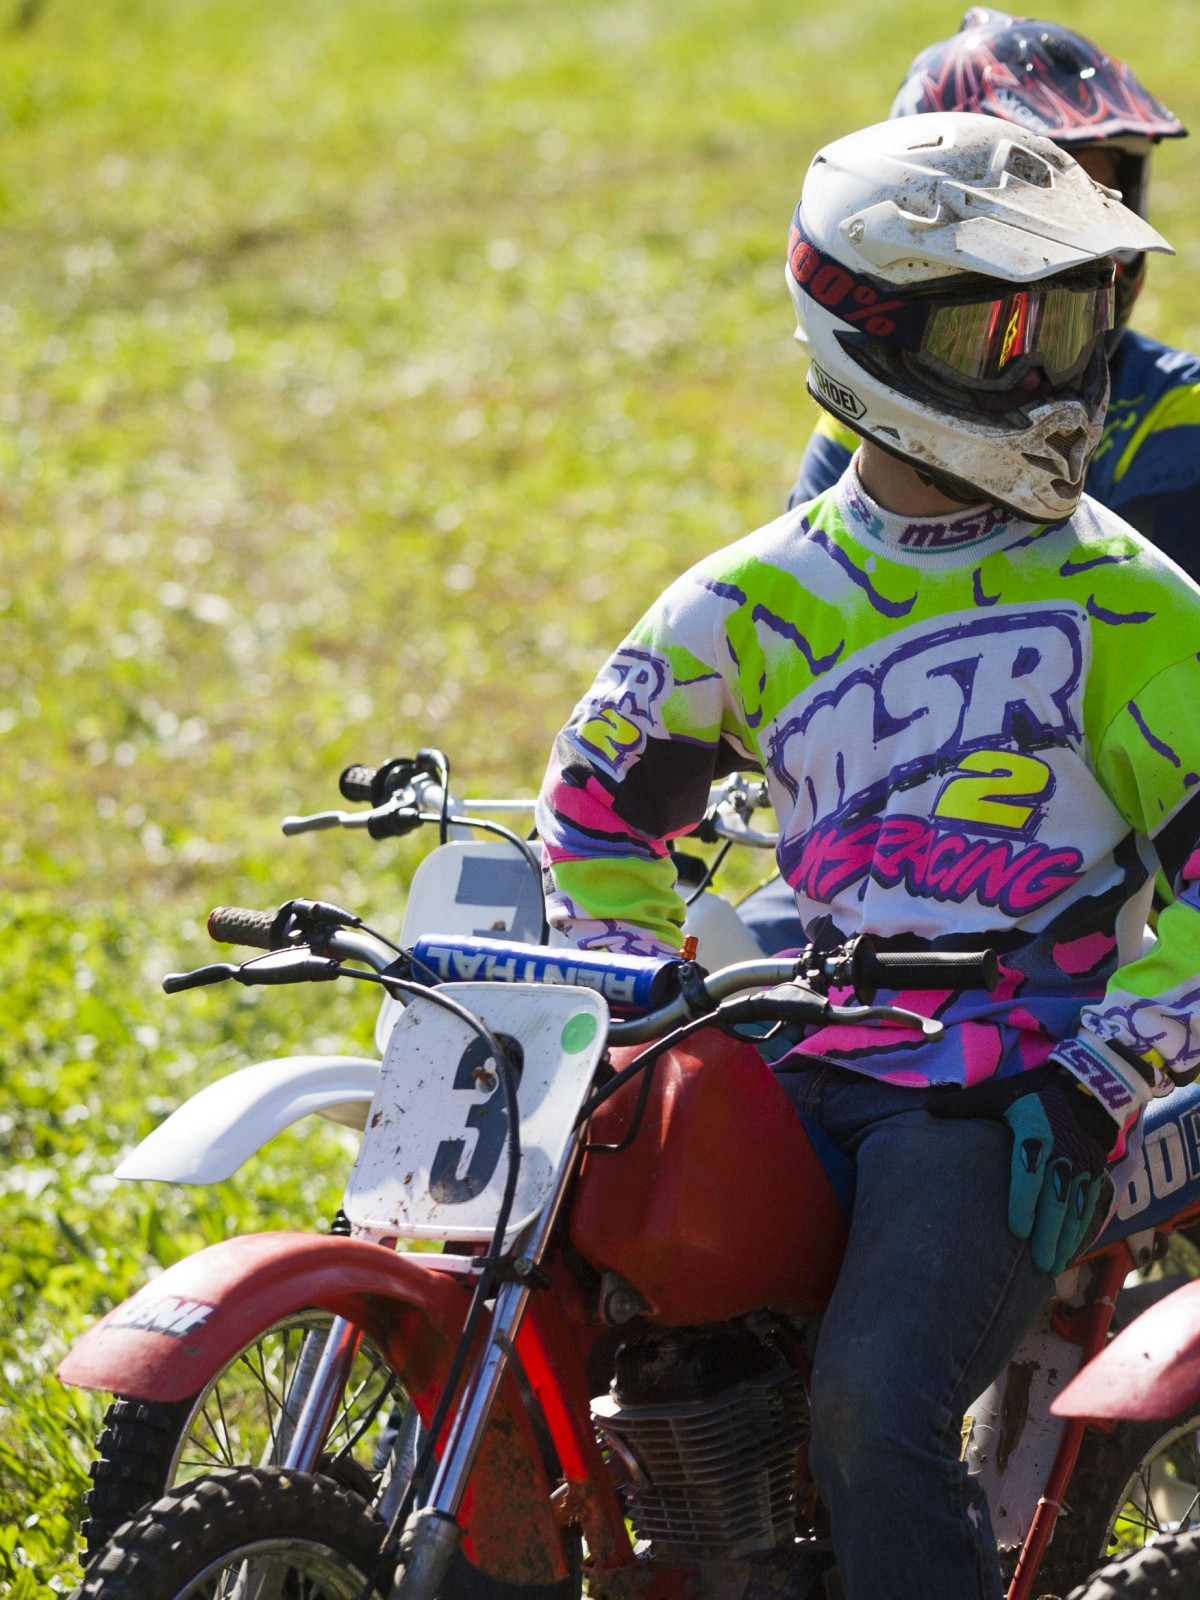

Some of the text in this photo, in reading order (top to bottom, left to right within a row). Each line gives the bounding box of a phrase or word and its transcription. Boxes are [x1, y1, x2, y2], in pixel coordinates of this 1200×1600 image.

[814, 366, 859, 415] SHOEI
[577, 703, 643, 775] 2
[767, 609, 1085, 848] MSR
[929, 748, 1057, 842] 2
[426, 946, 637, 1002] RENTHAL
[428, 1032, 525, 1204] 3
